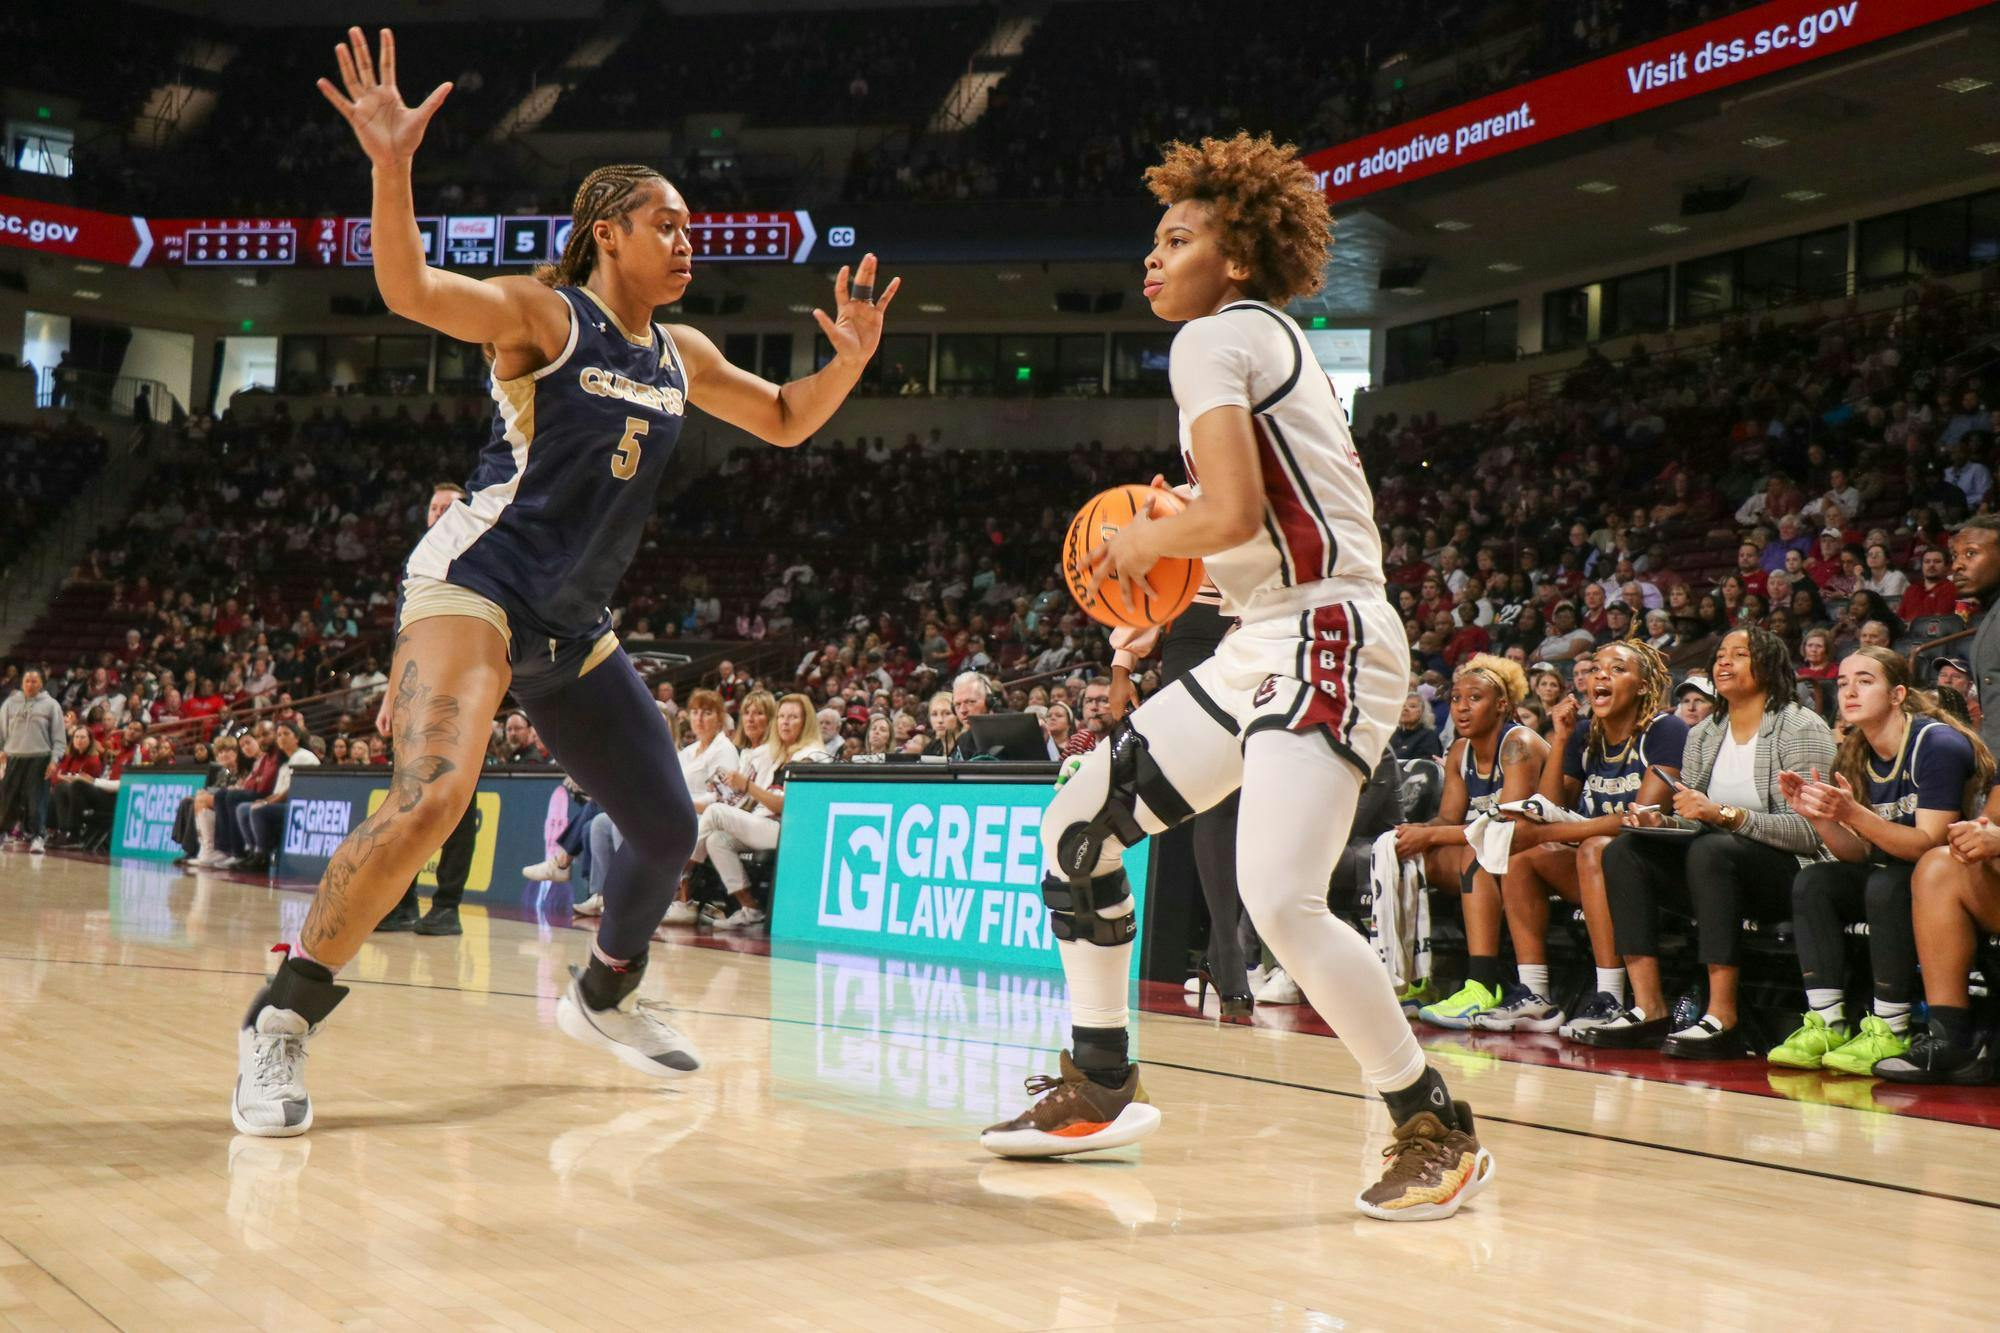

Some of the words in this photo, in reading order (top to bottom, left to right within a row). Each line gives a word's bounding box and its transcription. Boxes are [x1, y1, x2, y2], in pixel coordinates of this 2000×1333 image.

[1627, 51, 1687, 93] Visit
[1694, 1, 1858, 73] dss.sc.gov
[1333, 162, 1355, 187] or
[1359, 135, 1449, 179] adoptive
[1455, 102, 1536, 155] parent.
[746, 215, 758, 224] 10
[164, 236, 182, 246] PTS
[199, 235, 208, 246] 0
[239, 235, 248, 246] 0
[279, 235, 289, 246] 0
[321, 229, 334, 240] 4
[515, 231, 535, 252] 5
[724, 229, 734, 240] 0
[746, 229, 756, 240] 0
[767, 229, 778, 240] 0
[832, 230, 851, 243] CC
[198, 248, 207, 260] 0
[218, 248, 227, 260] 0
[238, 248, 247, 260] 0
[258, 248, 268, 260] 0
[278, 248, 288, 260] 0
[745, 243, 756, 254] 0
[767, 243, 778, 254] 0
[453, 251, 488, 264] 1:25
[611, 416, 649, 481] 5
[306, 799, 351, 834] GREEN
[302, 832, 325, 856] LAW
[896, 803, 1046, 886] GREE
[887, 882, 975, 941] LAW
